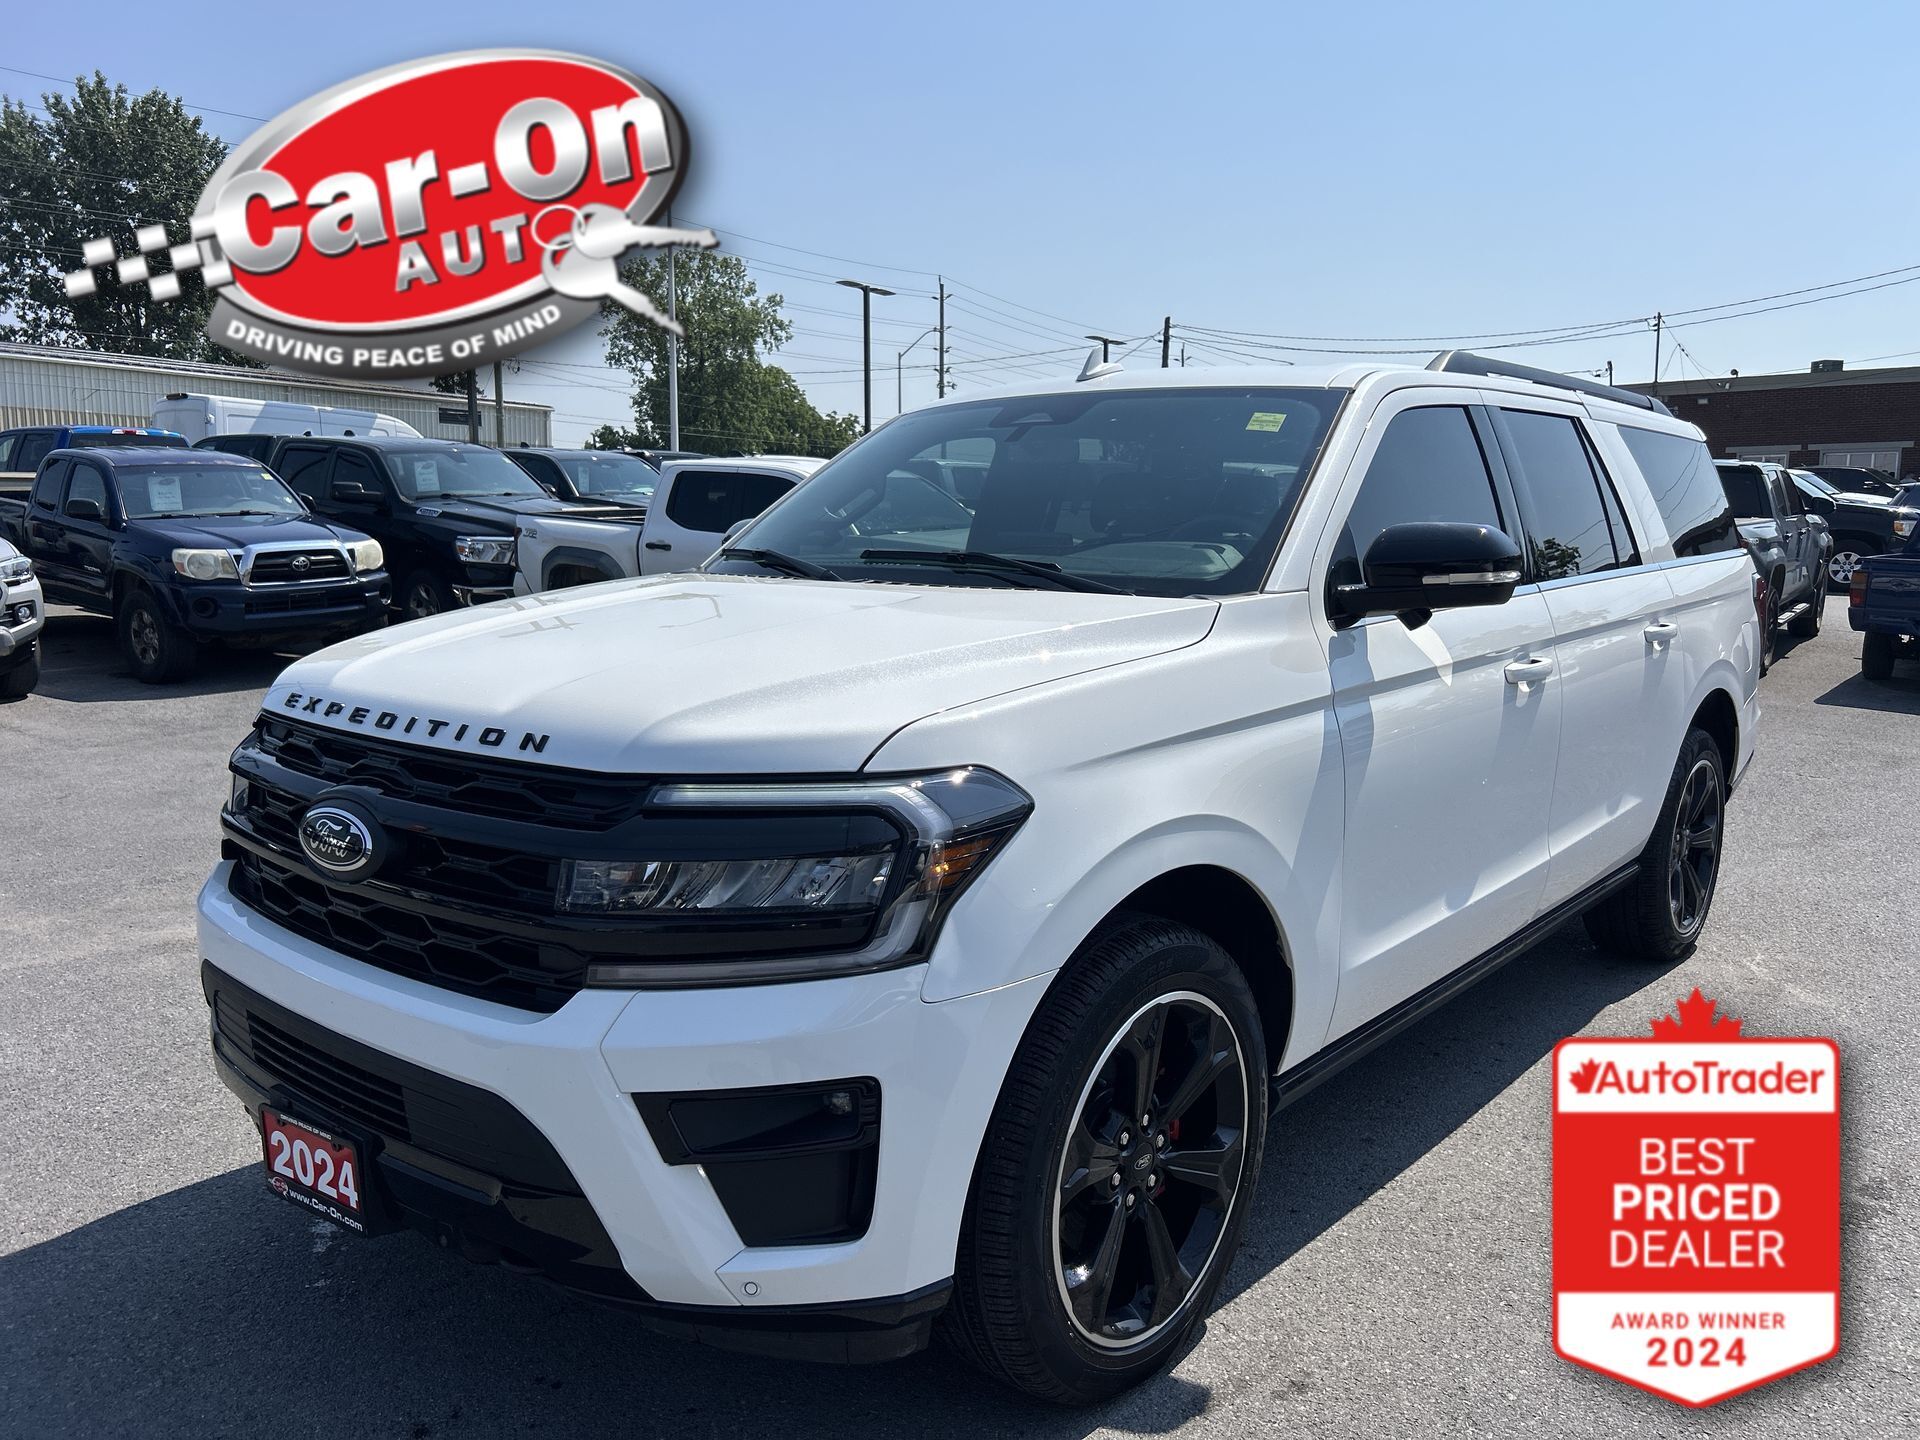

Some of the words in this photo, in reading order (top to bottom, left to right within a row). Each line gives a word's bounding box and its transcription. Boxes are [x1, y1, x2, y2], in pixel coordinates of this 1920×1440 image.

[284, 692, 550, 753] EXPEDITION
[310, 819, 351, 858] Ford
[270, 1130, 359, 1209] 2024
